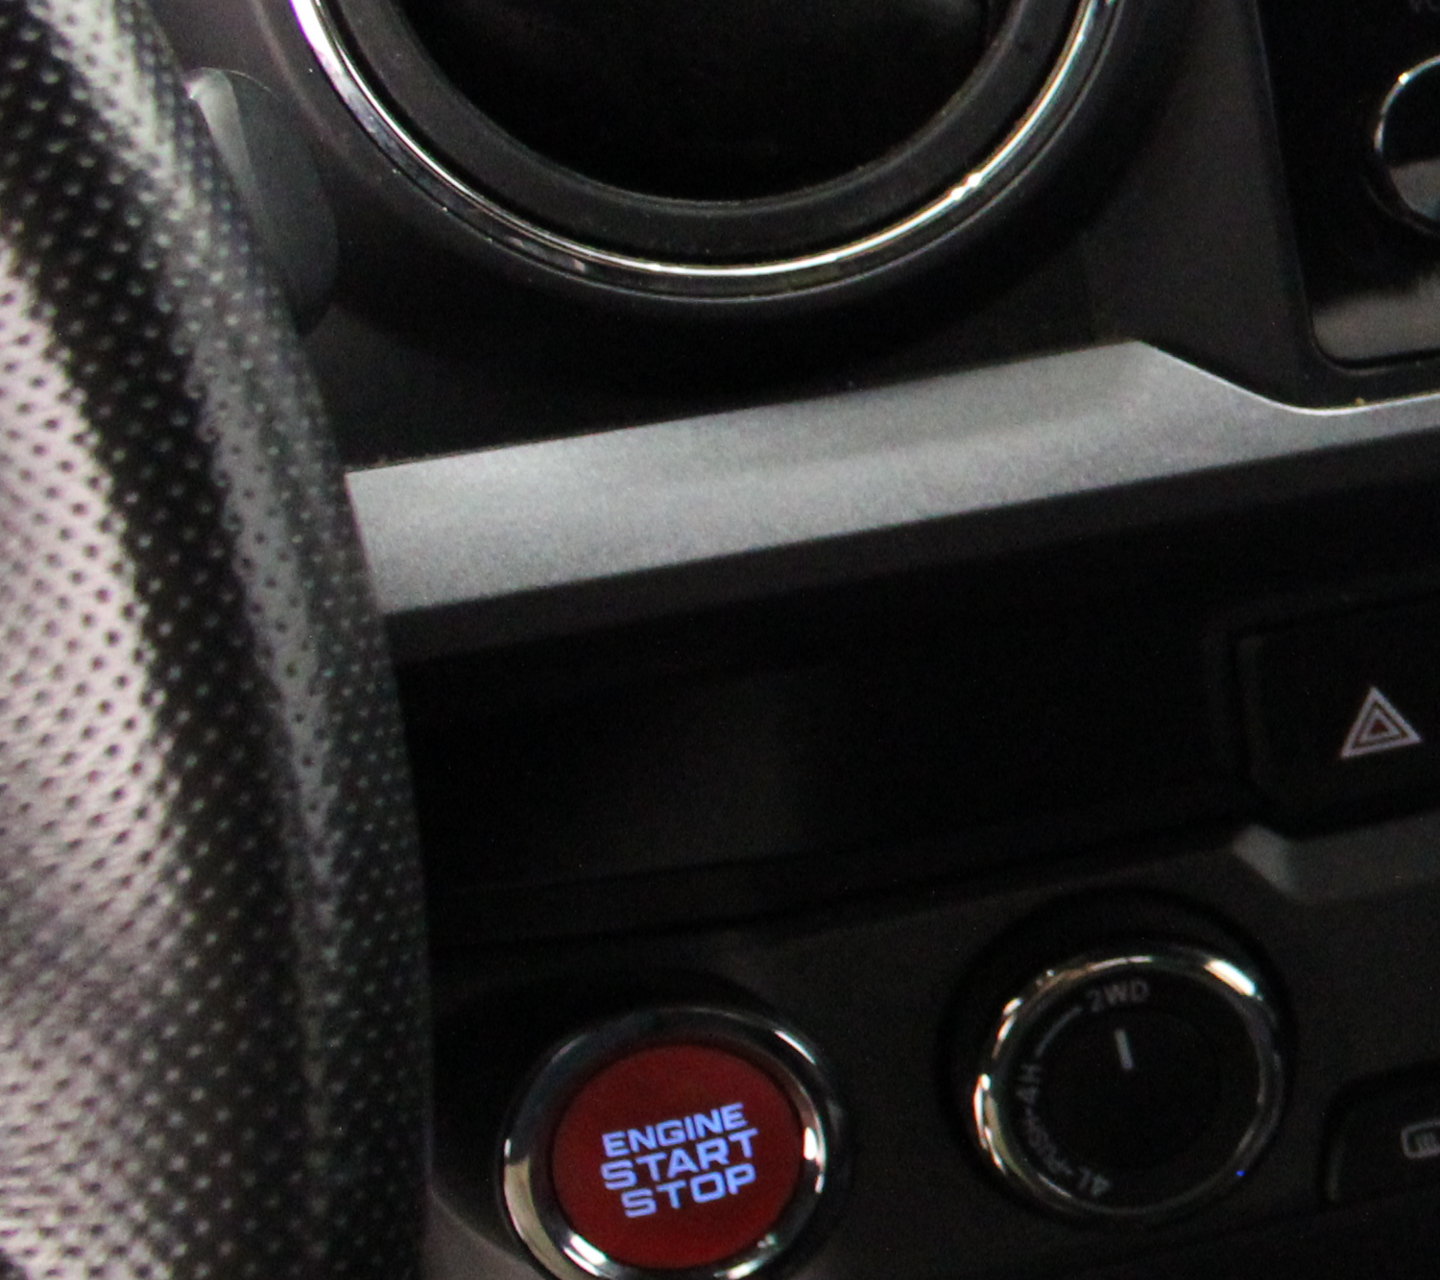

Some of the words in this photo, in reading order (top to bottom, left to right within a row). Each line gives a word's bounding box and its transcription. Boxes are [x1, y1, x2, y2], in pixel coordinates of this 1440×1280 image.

[602, 1104, 745, 1158] ENGINE
[601, 1128, 760, 1193] START
[621, 1163, 758, 1220] STOP
